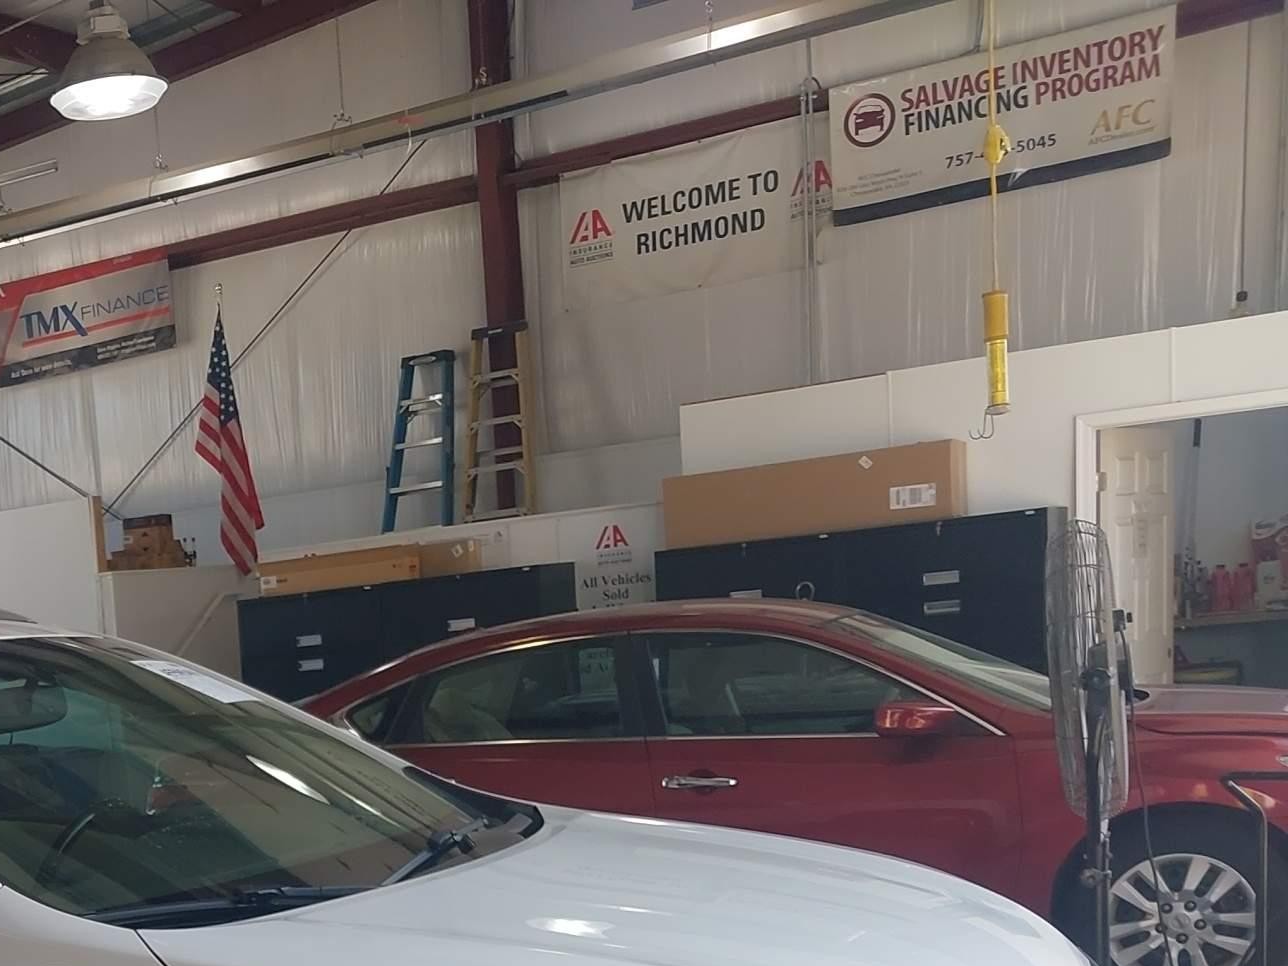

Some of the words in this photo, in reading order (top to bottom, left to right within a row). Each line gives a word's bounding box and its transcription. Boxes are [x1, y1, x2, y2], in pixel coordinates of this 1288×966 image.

[900, 66, 1006, 113] SALVAGE
[1012, 24, 1165, 86] INVENTORY
[904, 85, 1029, 136] FINANCNG
[1035, 53, 1160, 106] PROGRAM
[1090, 98, 1155, 136] AFC
[622, 178, 741, 224] WELCOME
[747, 169, 779, 196] TO
[636, 208, 765, 255] RICHMOND
[19, 301, 88, 338] TMX
[80, 284, 169, 321] FINANCE
[583, 575, 598, 589] All
[601, 572, 652, 586] Vehicles
[602, 586, 630, 600] Sold
